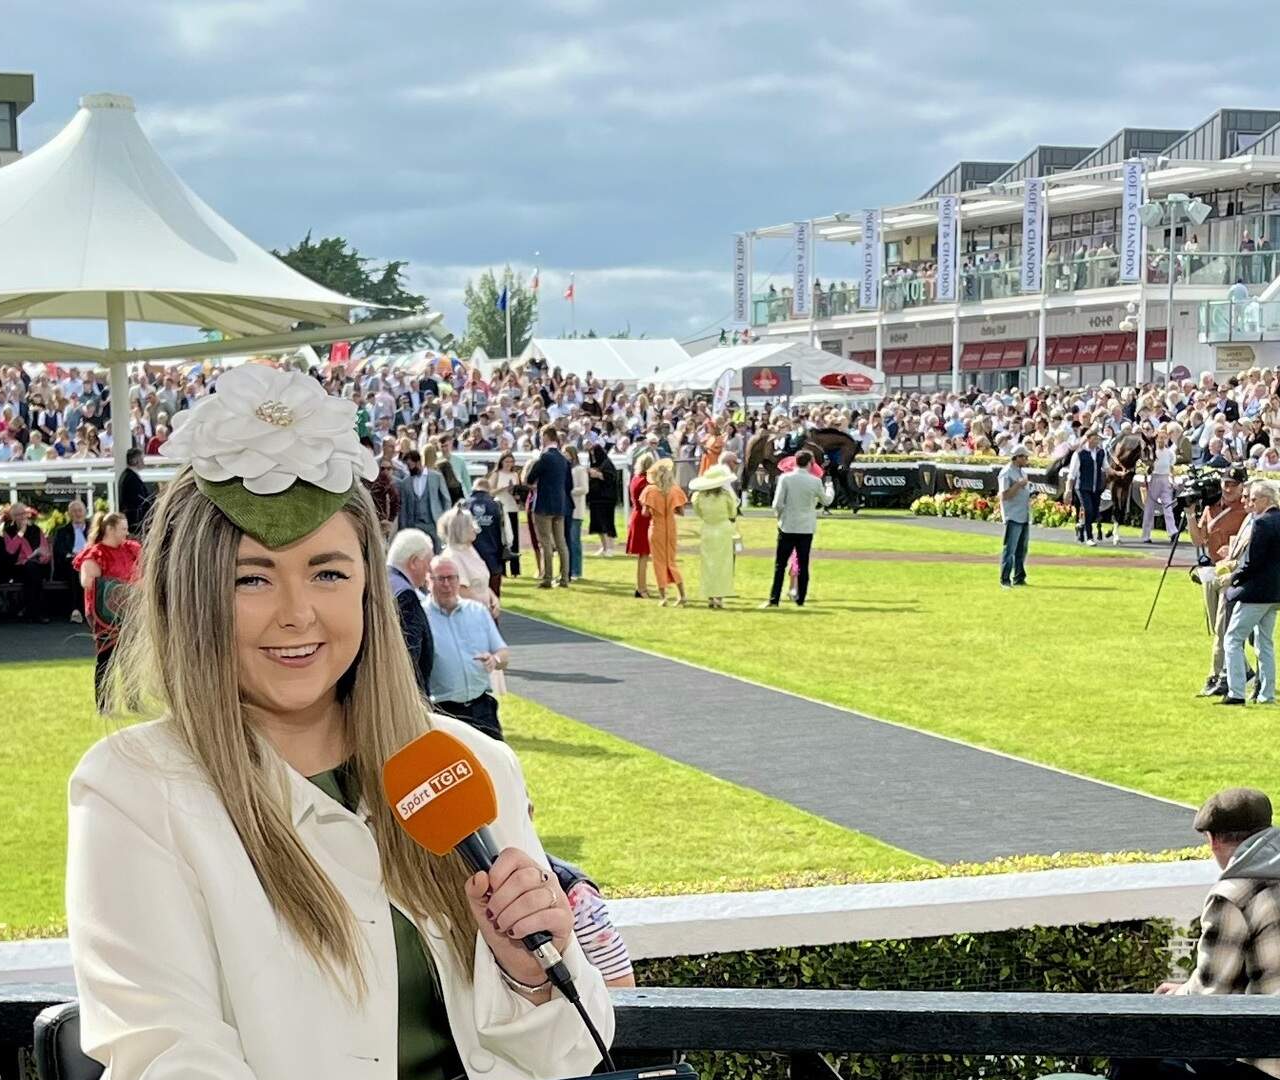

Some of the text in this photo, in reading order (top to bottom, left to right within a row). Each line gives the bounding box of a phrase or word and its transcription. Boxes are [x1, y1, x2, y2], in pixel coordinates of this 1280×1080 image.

[1026, 229, 1037, 287] CHANDON
[1126, 213, 1137, 276] CHANDON
[942, 242, 952, 297] CHANDON
[863, 475, 906, 487] GUINNESS
[953, 477, 984, 489] GUINNESS
[401, 789, 431, 815] Spórt
